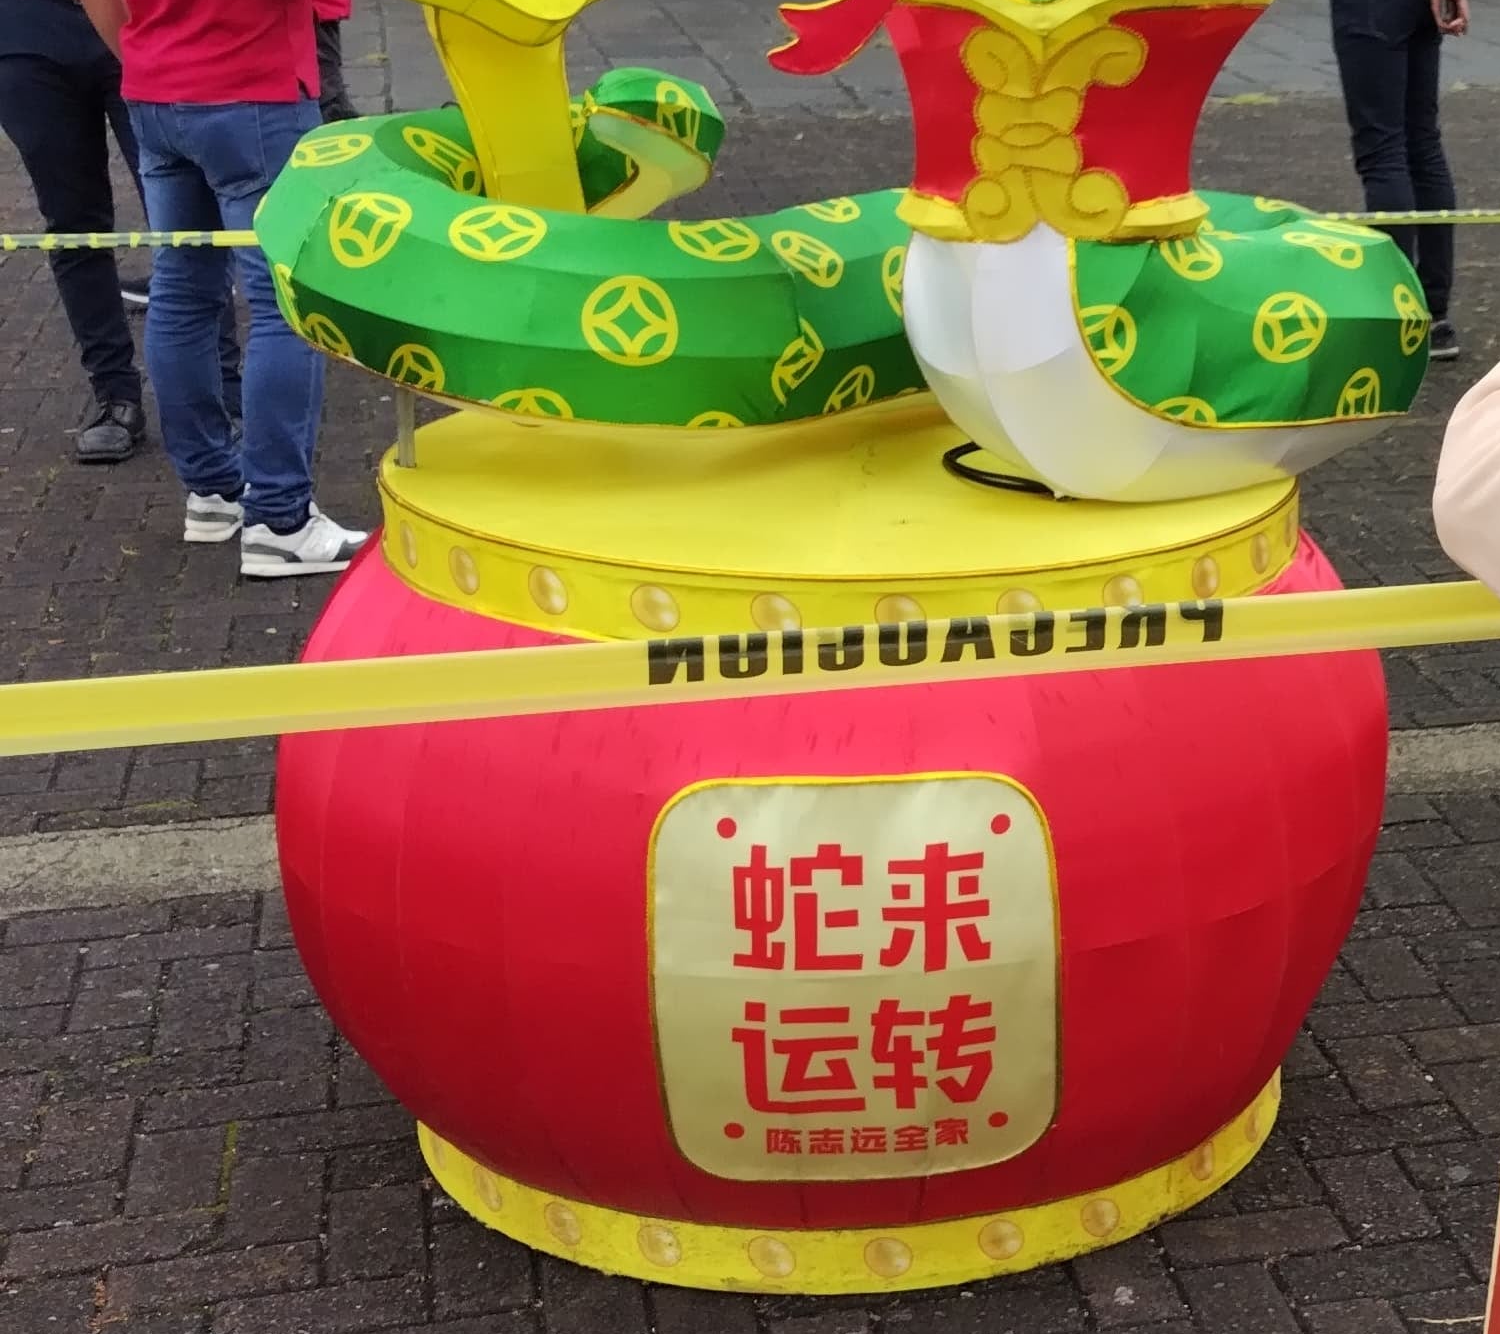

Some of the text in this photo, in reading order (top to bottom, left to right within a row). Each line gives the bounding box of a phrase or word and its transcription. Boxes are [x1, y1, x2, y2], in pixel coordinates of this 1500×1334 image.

[732, 842, 992, 972] 蛇来
[731, 994, 997, 1114] 运转
[766, 1118, 969, 1155] 陈志远全家
